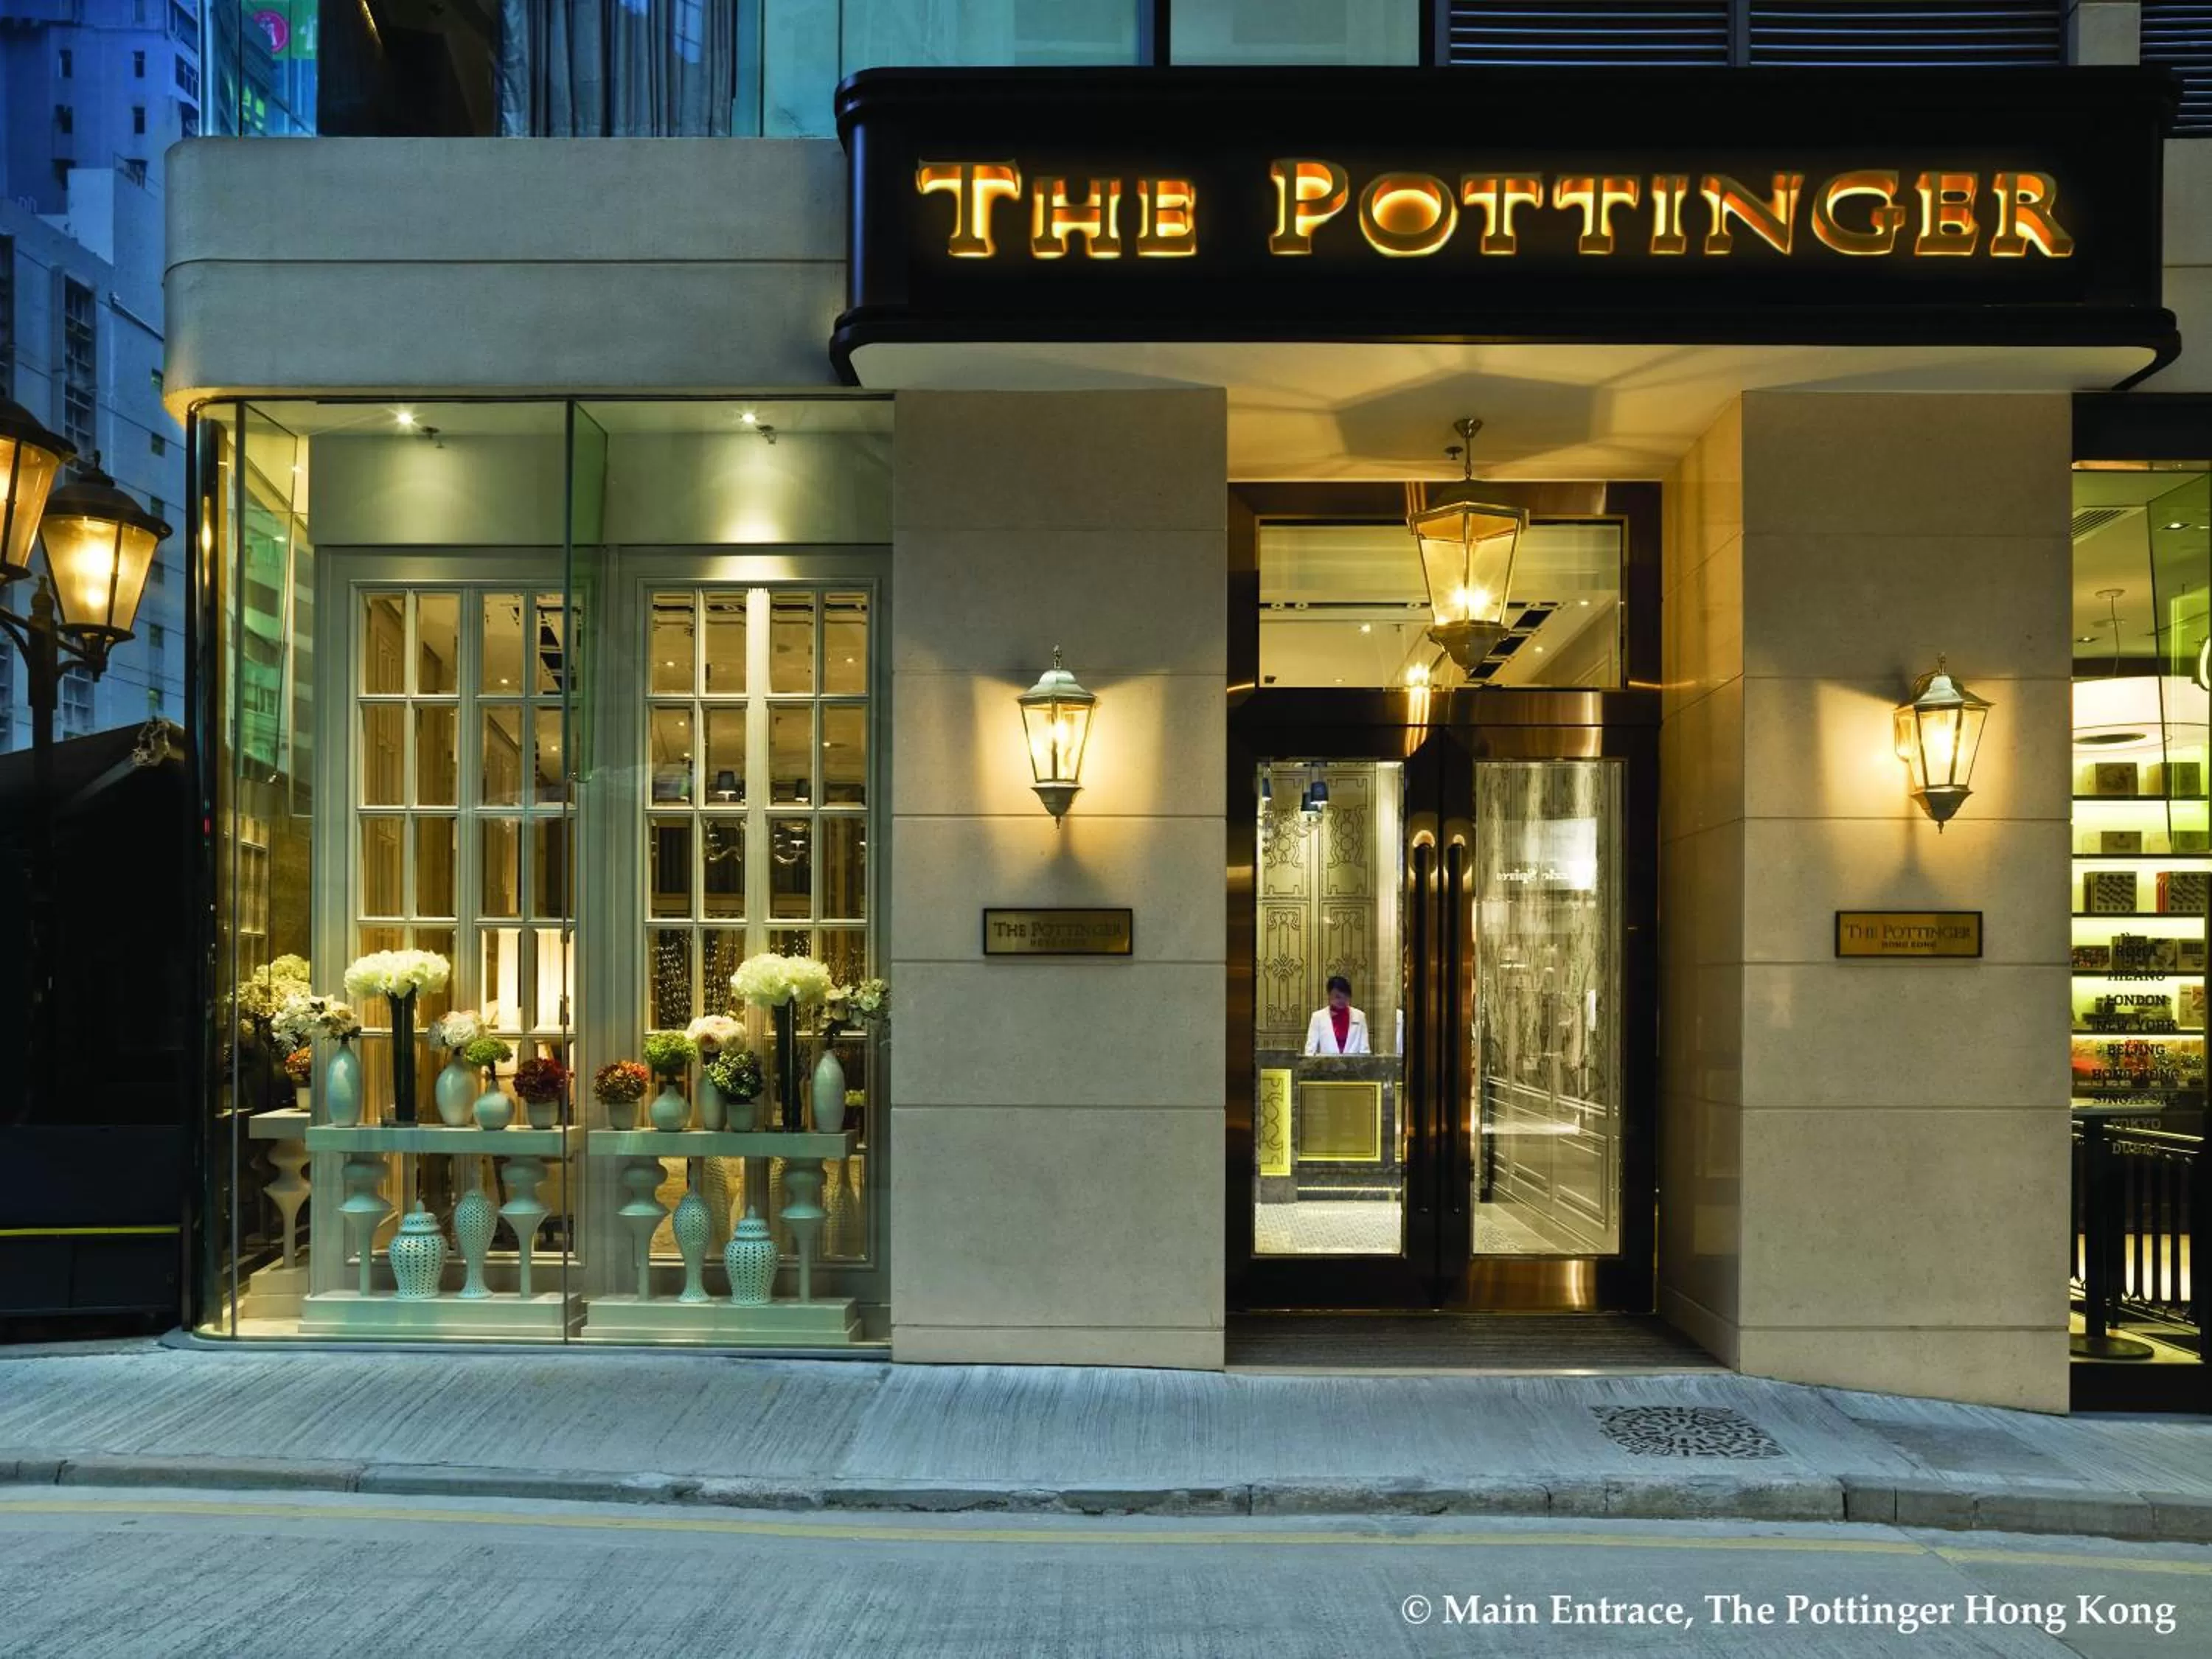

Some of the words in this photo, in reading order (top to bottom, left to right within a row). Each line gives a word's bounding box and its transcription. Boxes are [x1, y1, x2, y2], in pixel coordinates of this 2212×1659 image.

[915, 159, 1199, 258] THE
[1270, 157, 2076, 258] POTTINGER
[2106, 995, 2166, 1006] LONDON
[2107, 1044, 2166, 1055] BEIJING
